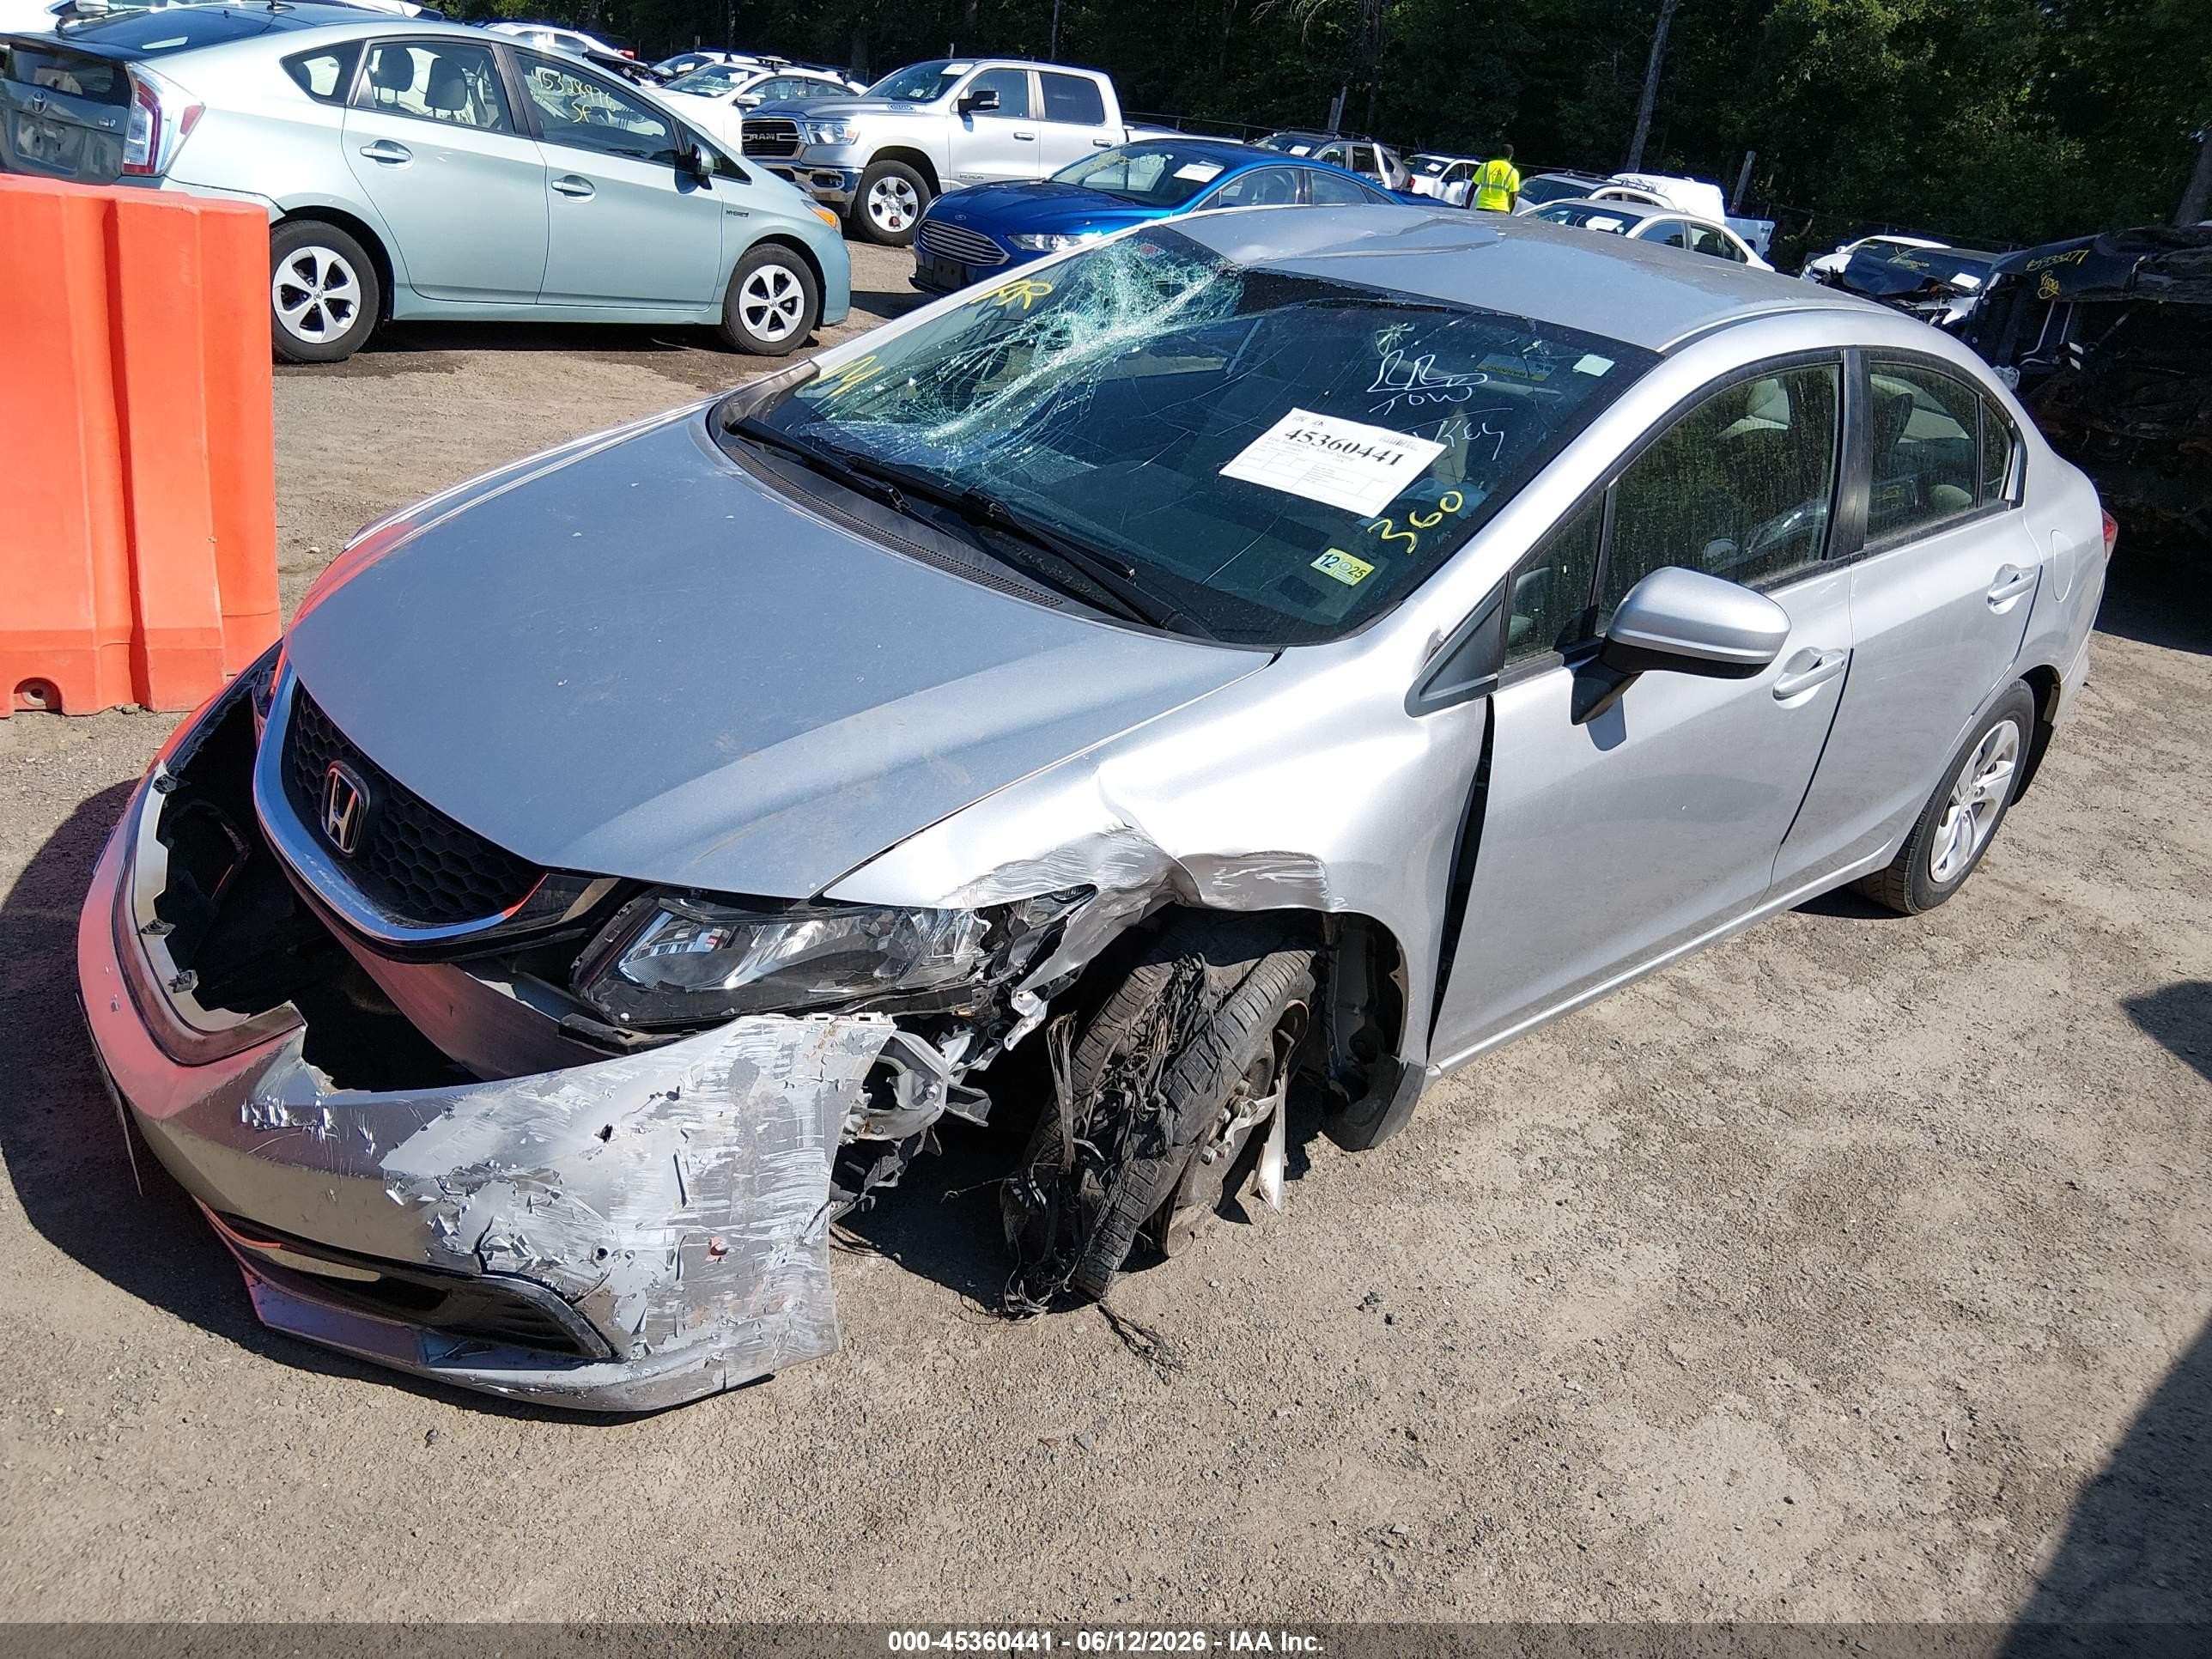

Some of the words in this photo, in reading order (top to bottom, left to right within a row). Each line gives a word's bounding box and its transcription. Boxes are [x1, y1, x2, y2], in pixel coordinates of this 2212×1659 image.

[750, 132, 776, 141] RAM
[1284, 428, 1405, 468] 45360441
[1366, 489, 1465, 556] 360
[1319, 553, 1340, 569] 12
[1347, 566, 1368, 579] 25
